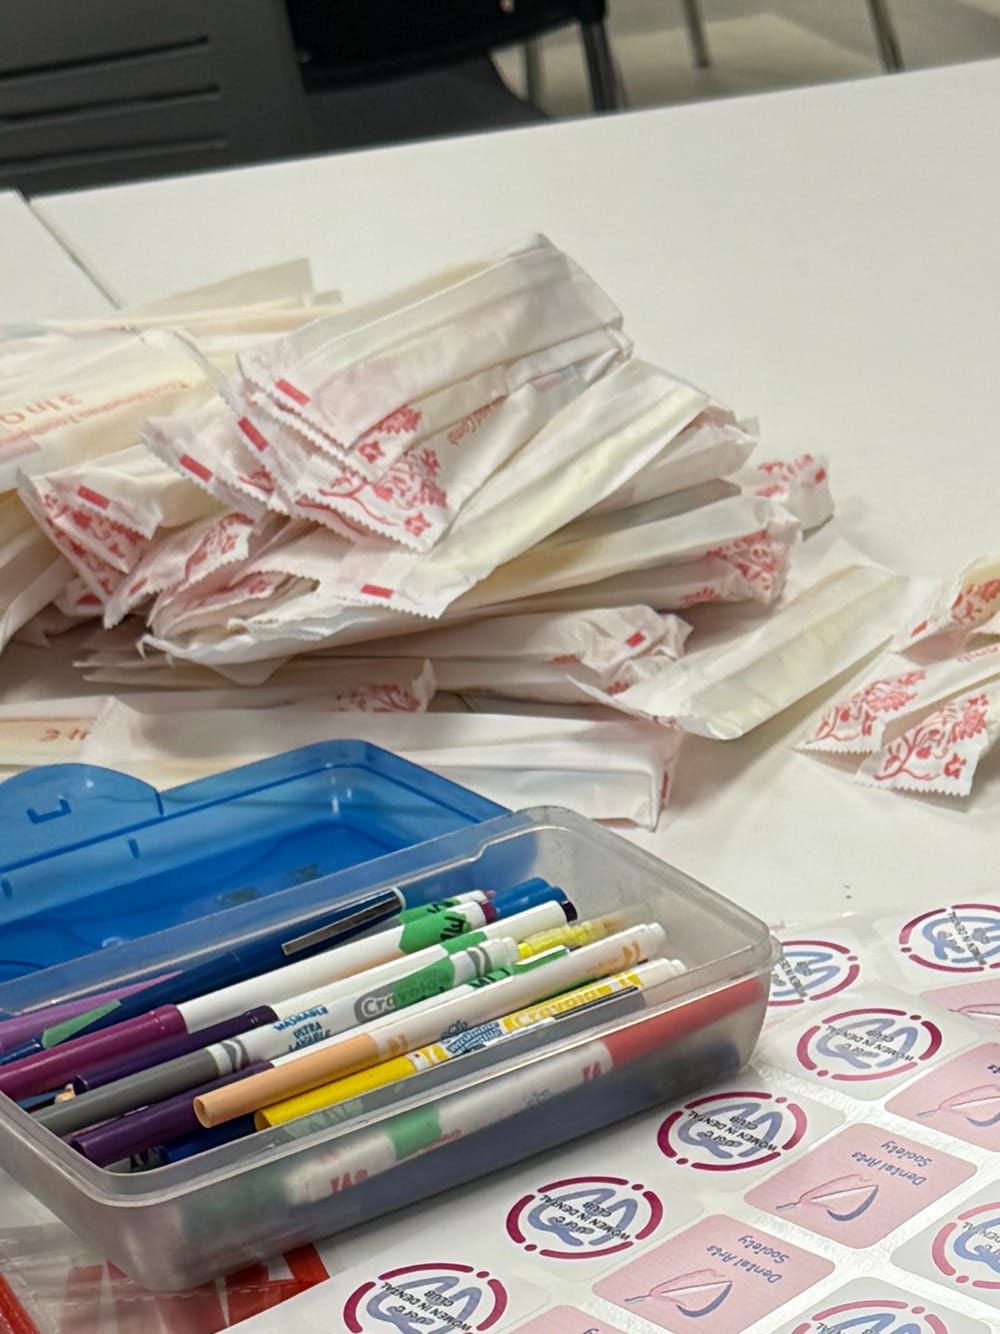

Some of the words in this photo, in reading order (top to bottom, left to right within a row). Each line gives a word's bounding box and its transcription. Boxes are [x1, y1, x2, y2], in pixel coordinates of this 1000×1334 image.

[851, 1151, 882, 1167] Arts
[880, 1140, 932, 1167] Society
[877, 1162, 927, 1186] Dental
[539, 1194, 580, 1216] DENTAL
[588, 1217, 630, 1240] WOMEN
[705, 1244, 738, 1262] Arts
[737, 1234, 790, 1263] Society
[732, 1257, 782, 1283] Dental
[380, 1281, 421, 1305] DENTAL
[428, 1307, 472, 1331] WOMEN
